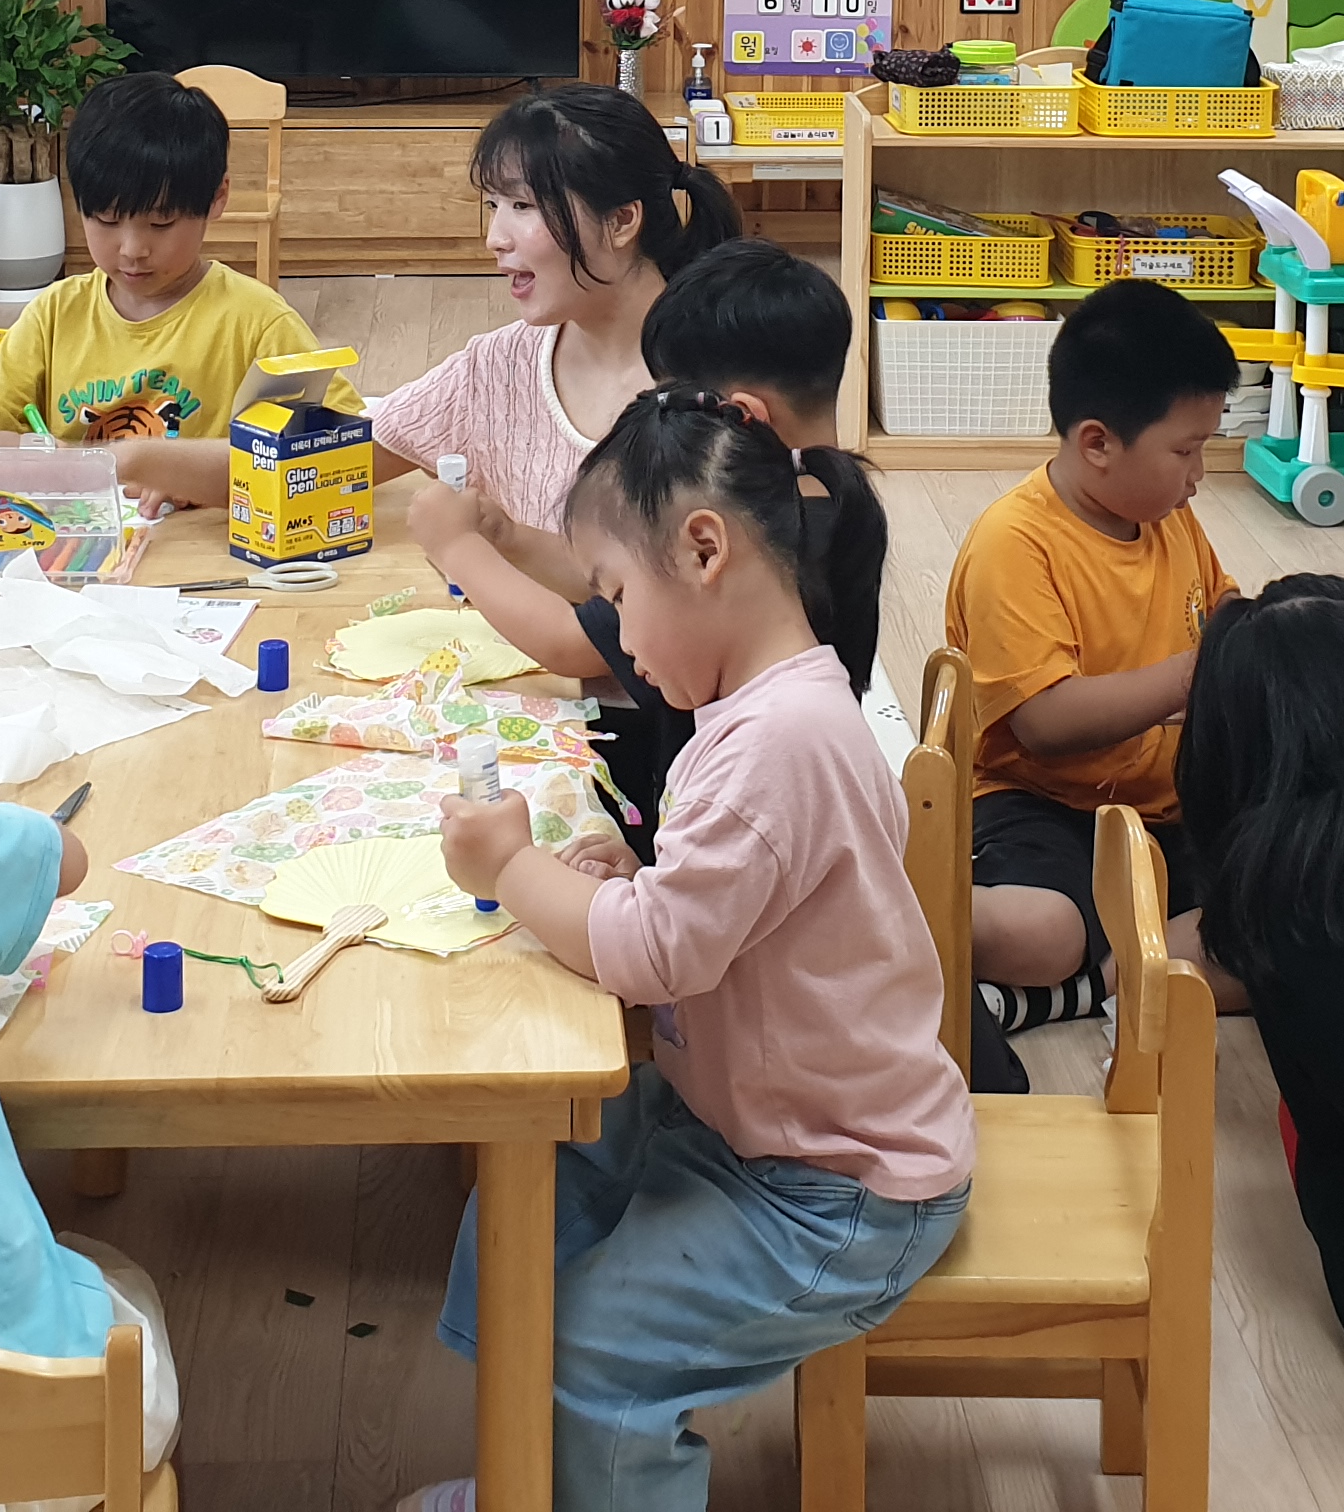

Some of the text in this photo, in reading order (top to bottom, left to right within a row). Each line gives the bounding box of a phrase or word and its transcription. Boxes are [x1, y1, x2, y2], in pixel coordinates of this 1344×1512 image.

[867, 0, 878, 14] 일
[740, 36, 757, 58] 월
[714, 120, 720, 140] 1
[131, 368, 202, 420] TEAM
[251, 438, 278, 459] Glue
[286, 467, 317, 485] Glue
[316, 476, 343, 489] LIQUID
[346, 470, 368, 482] GLUE
